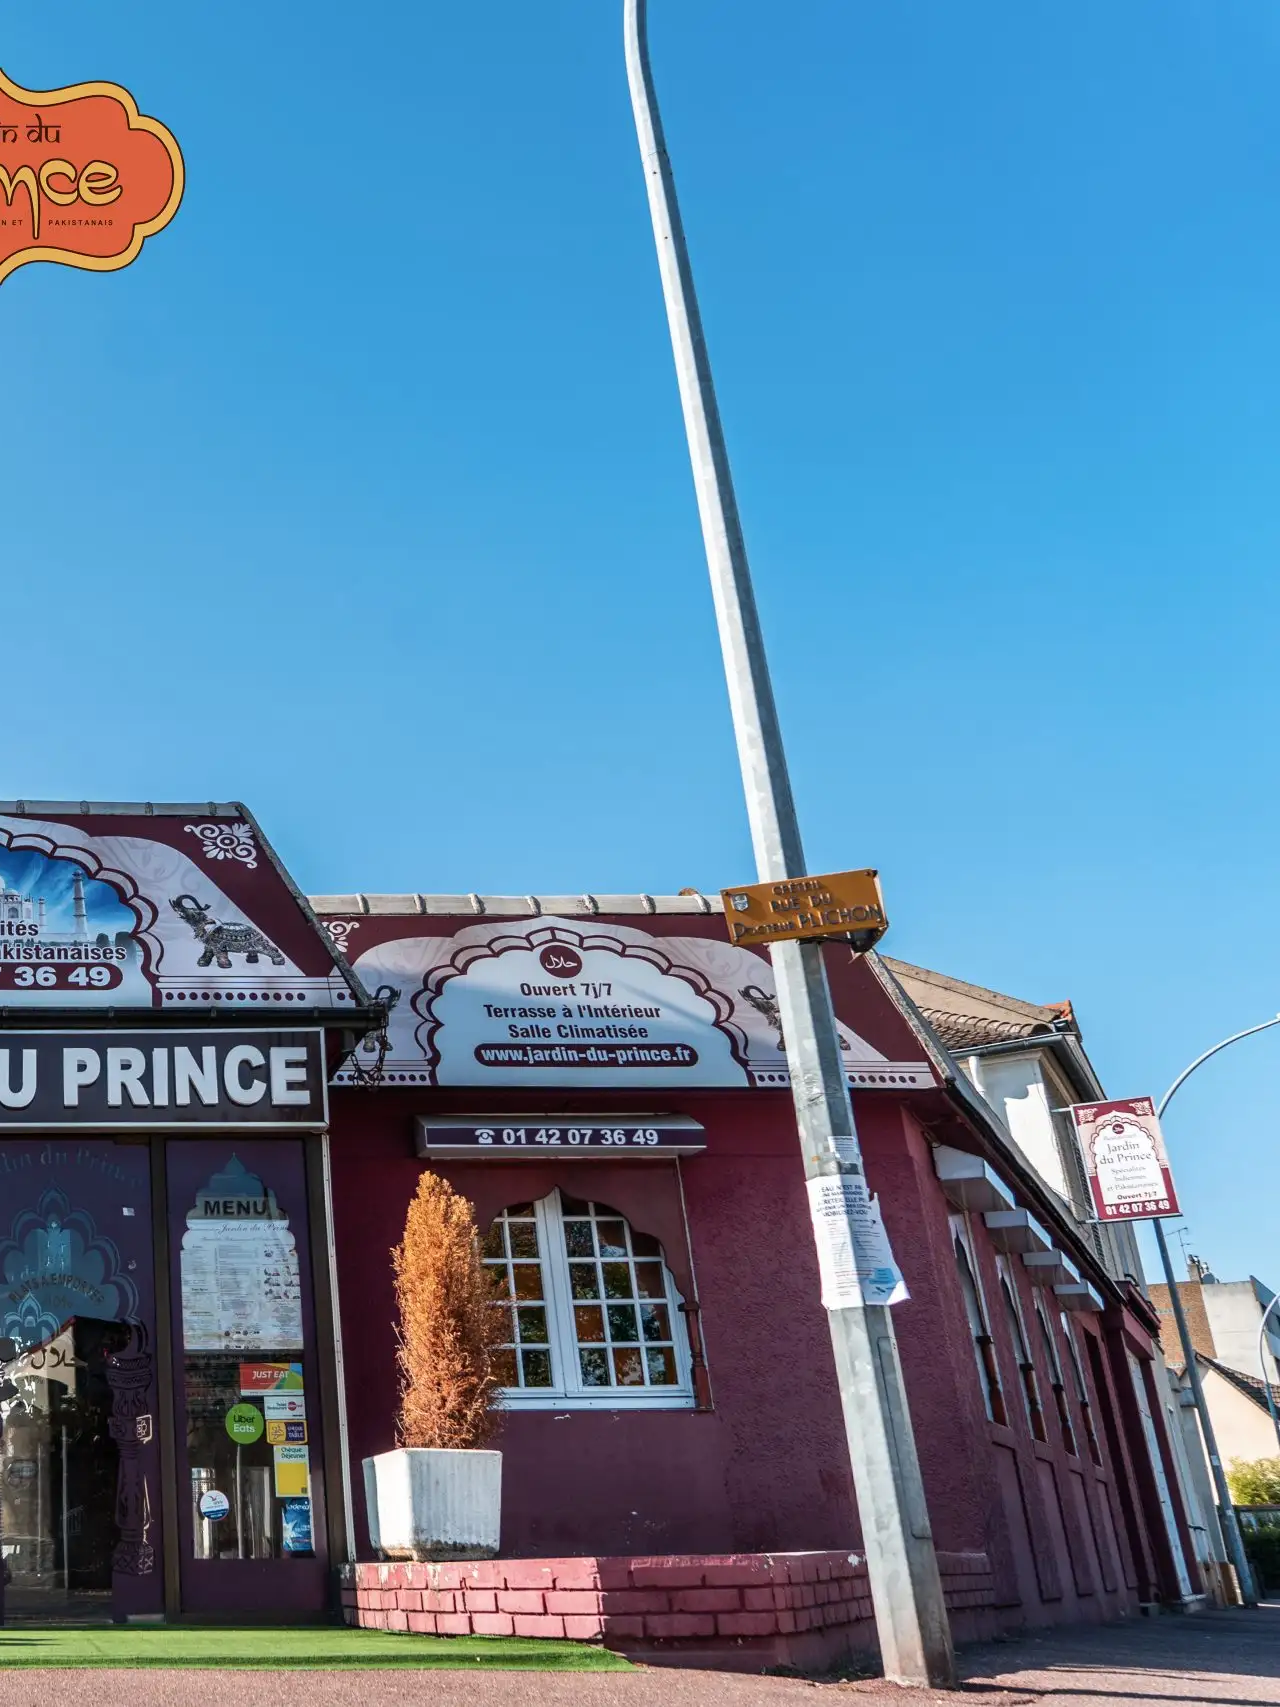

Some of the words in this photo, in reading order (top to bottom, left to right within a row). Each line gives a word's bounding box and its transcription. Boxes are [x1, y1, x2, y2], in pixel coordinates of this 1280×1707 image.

[769, 897, 800, 912] RUE
[808, 893, 831, 907] DU
[797, 904, 882, 928] PLICHON
[545, 955, 578, 970] حلال
[14, 965, 57, 987] 36
[68, 966, 111, 987] 49
[520, 982, 574, 996] Ouvert
[581, 982, 612, 999] 7j/7
[484, 1004, 556, 1018] Terrasse
[563, 1004, 573, 1018] à
[579, 1004, 661, 1019] l'Intérieur
[509, 1025, 551, 1038] Salle
[557, 1025, 648, 1039] Climatisée
[481, 1046, 691, 1064] www.jardin-du-prince.fr
[62, 1045, 311, 1108] PRINCE
[502, 1129, 525, 1144] 01
[535, 1129, 560, 1144] 42
[567, 1129, 592, 1144] 07
[600, 1129, 626, 1144] 36
[632, 1129, 658, 1144] 49
[1107, 1141, 1140, 1154] Jardin
[1100, 1155, 1114, 1164] du
[1117, 1153, 1152, 1162] Prince
[204, 1200, 267, 1216] MENU
[1105, 1205, 1117, 1215] 01
[1119, 1204, 1131, 1214] 42
[1131, 1203, 1143, 1212] 07
[1144, 1202, 1157, 1211] 36
[1158, 1200, 1170, 1210] 49
[252, 1371, 272, 1379] JUST
[233, 1414, 255, 1423] Uber
[233, 1424, 255, 1433] Eats
